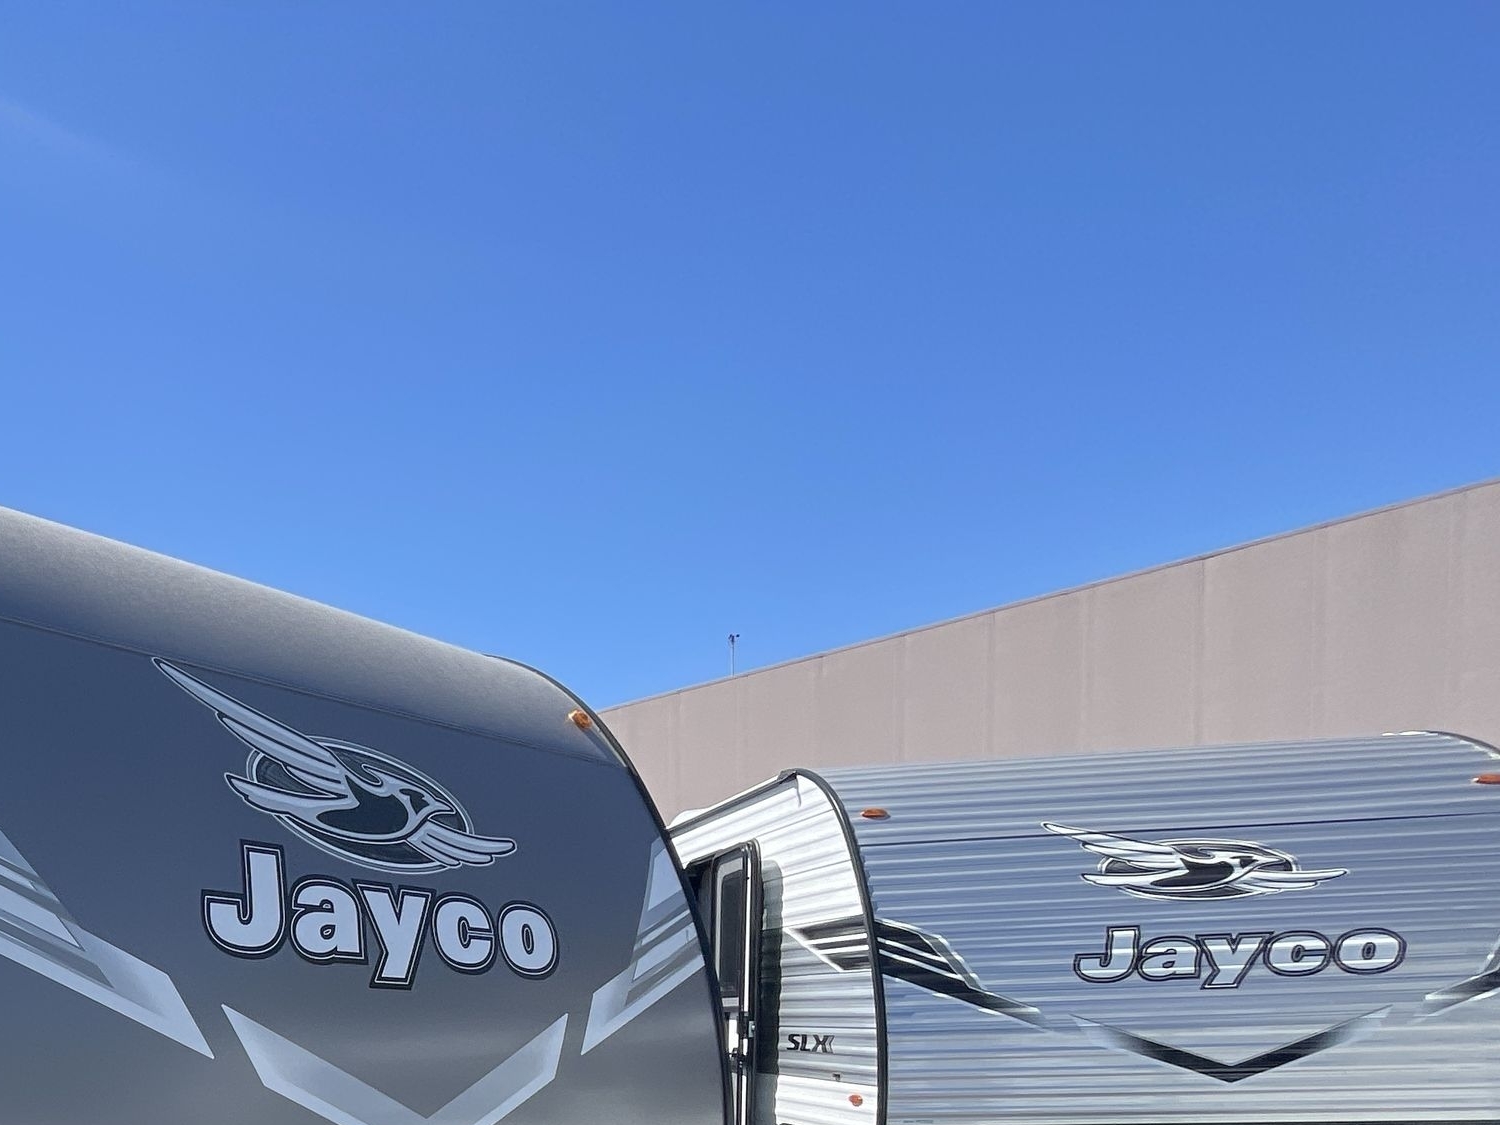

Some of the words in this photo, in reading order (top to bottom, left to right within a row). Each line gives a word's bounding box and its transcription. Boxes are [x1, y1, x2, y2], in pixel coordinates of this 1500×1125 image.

[200, 838, 561, 991] Jayco
[1073, 924, 1408, 991] Jayco
[786, 1033, 835, 1053] SLX
